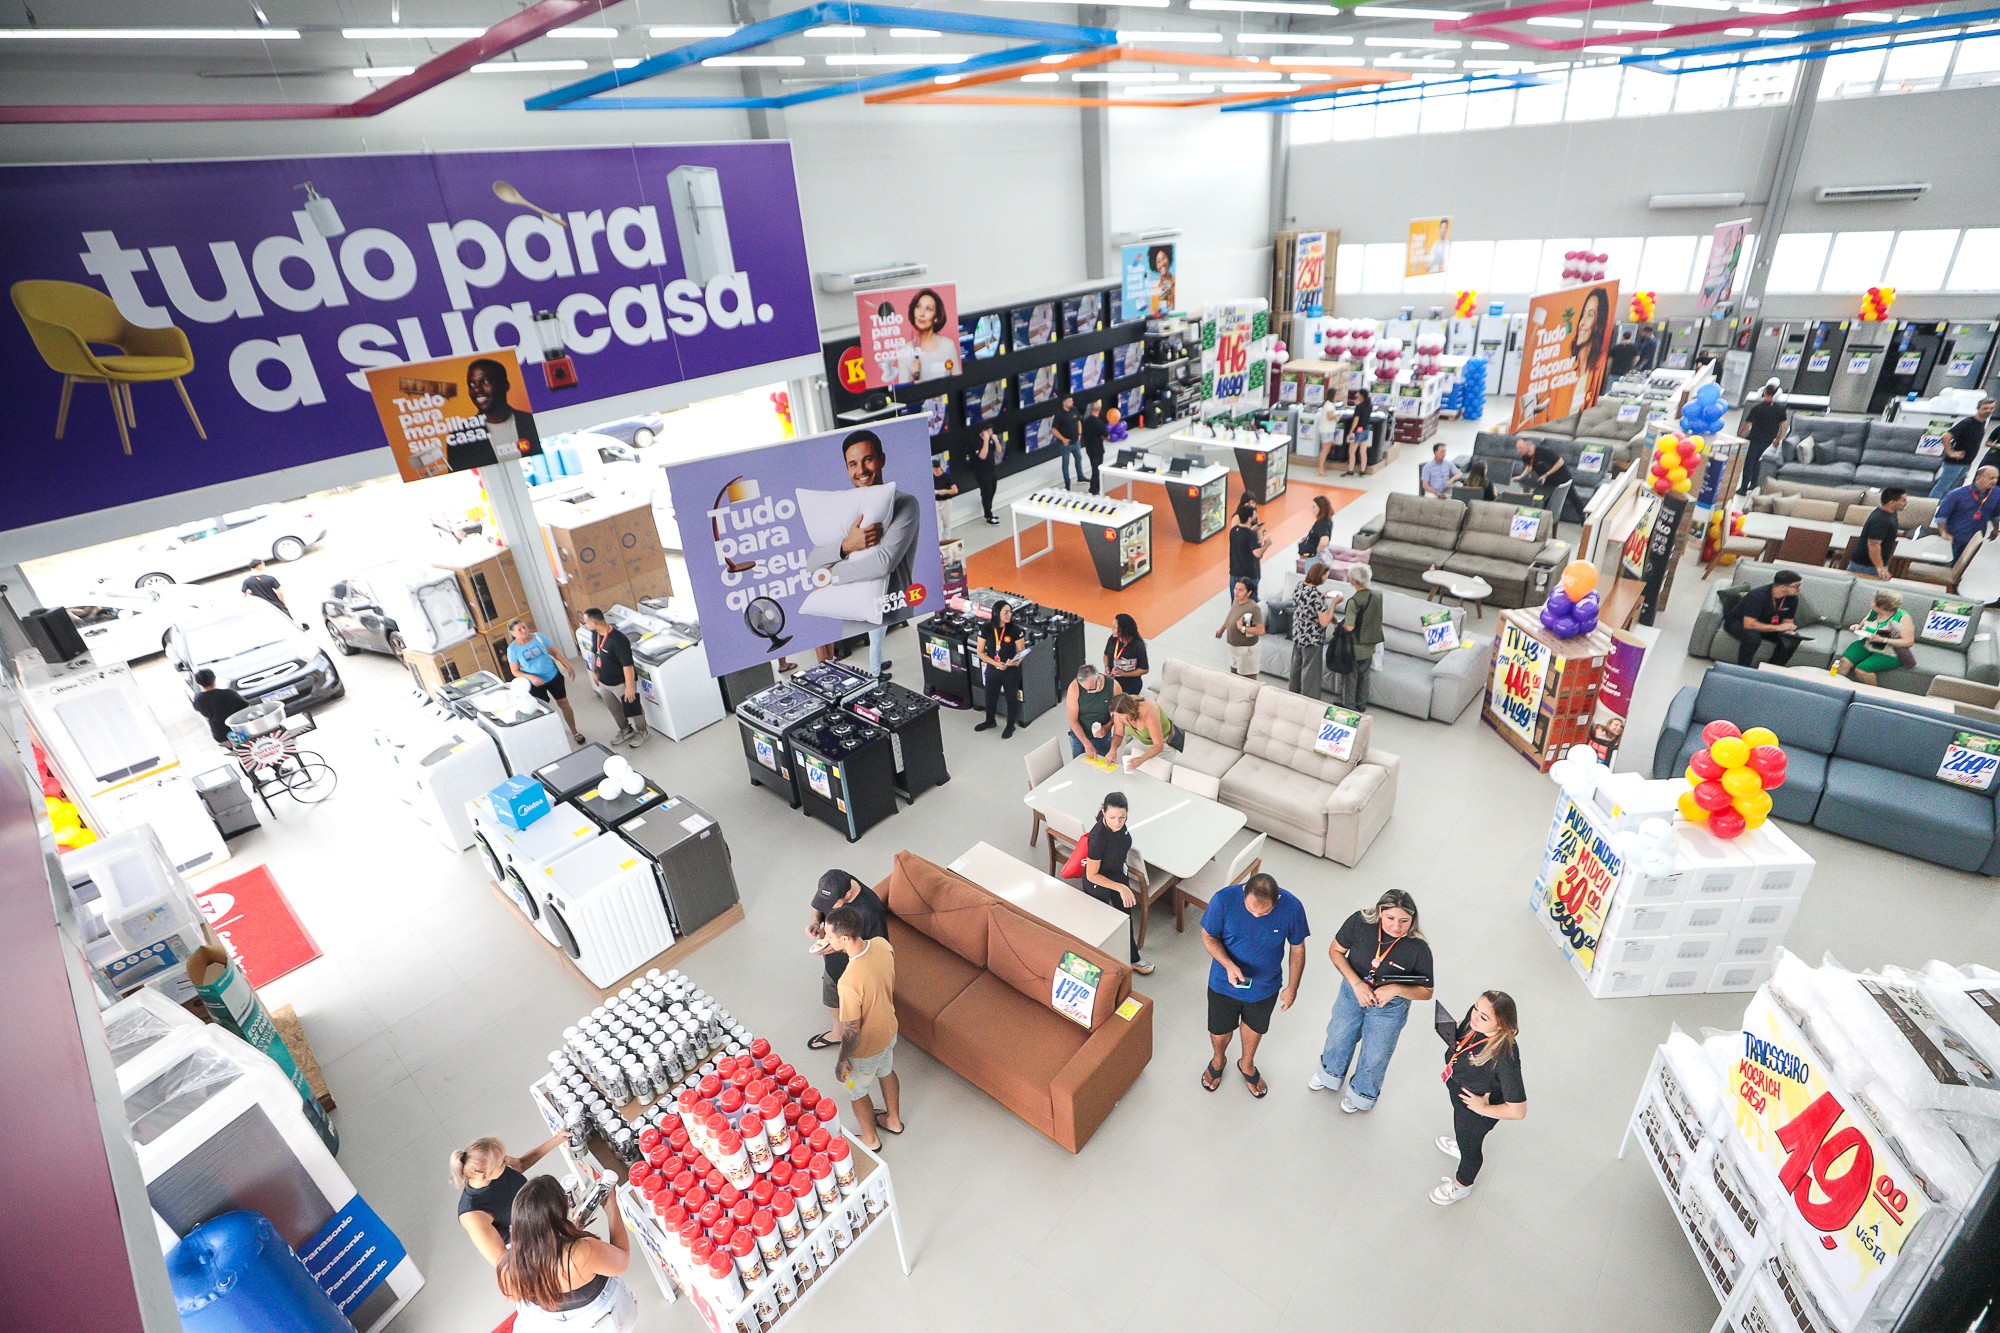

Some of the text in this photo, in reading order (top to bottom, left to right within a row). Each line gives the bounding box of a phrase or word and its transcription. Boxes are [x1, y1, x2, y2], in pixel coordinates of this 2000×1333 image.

[80, 205, 666, 328] tudo para
[870, 312, 904, 328] Tudo
[871, 325, 901, 341] para
[229, 334, 331, 412] a
[556, 270, 775, 357] casa.
[873, 337, 906, 351] a sua
[1537, 323, 1567, 348] Tudo
[1532, 343, 1561, 366] para
[1529, 355, 1577, 382] decorar
[1527, 378, 1549, 395] sua
[392, 393, 446, 414] Tudo
[398, 409, 444, 429] para
[401, 414, 488, 441] mobilhar
[407, 436, 443, 454] sua
[706, 496, 796, 536] Tudo
[714, 525, 791, 566] para
[720, 548, 808, 587] o seu
[725, 567, 840, 614] quarto.
[908, 587, 923, 602] K
[1507, 625, 1521, 650] TV
[517, 798, 544, 817] Midea
[1742, 1030, 1810, 1085] TRAVESSEIRO
[1739, 1058, 1781, 1101] KOERICH
[1740, 1081, 1766, 1115] CASA
[301, 1215, 354, 1265] Panasonic
[313, 1230, 365, 1282] Panasonic
[325, 1245, 377, 1297] Panasonic
[338, 1259, 388, 1311] Panasonic
